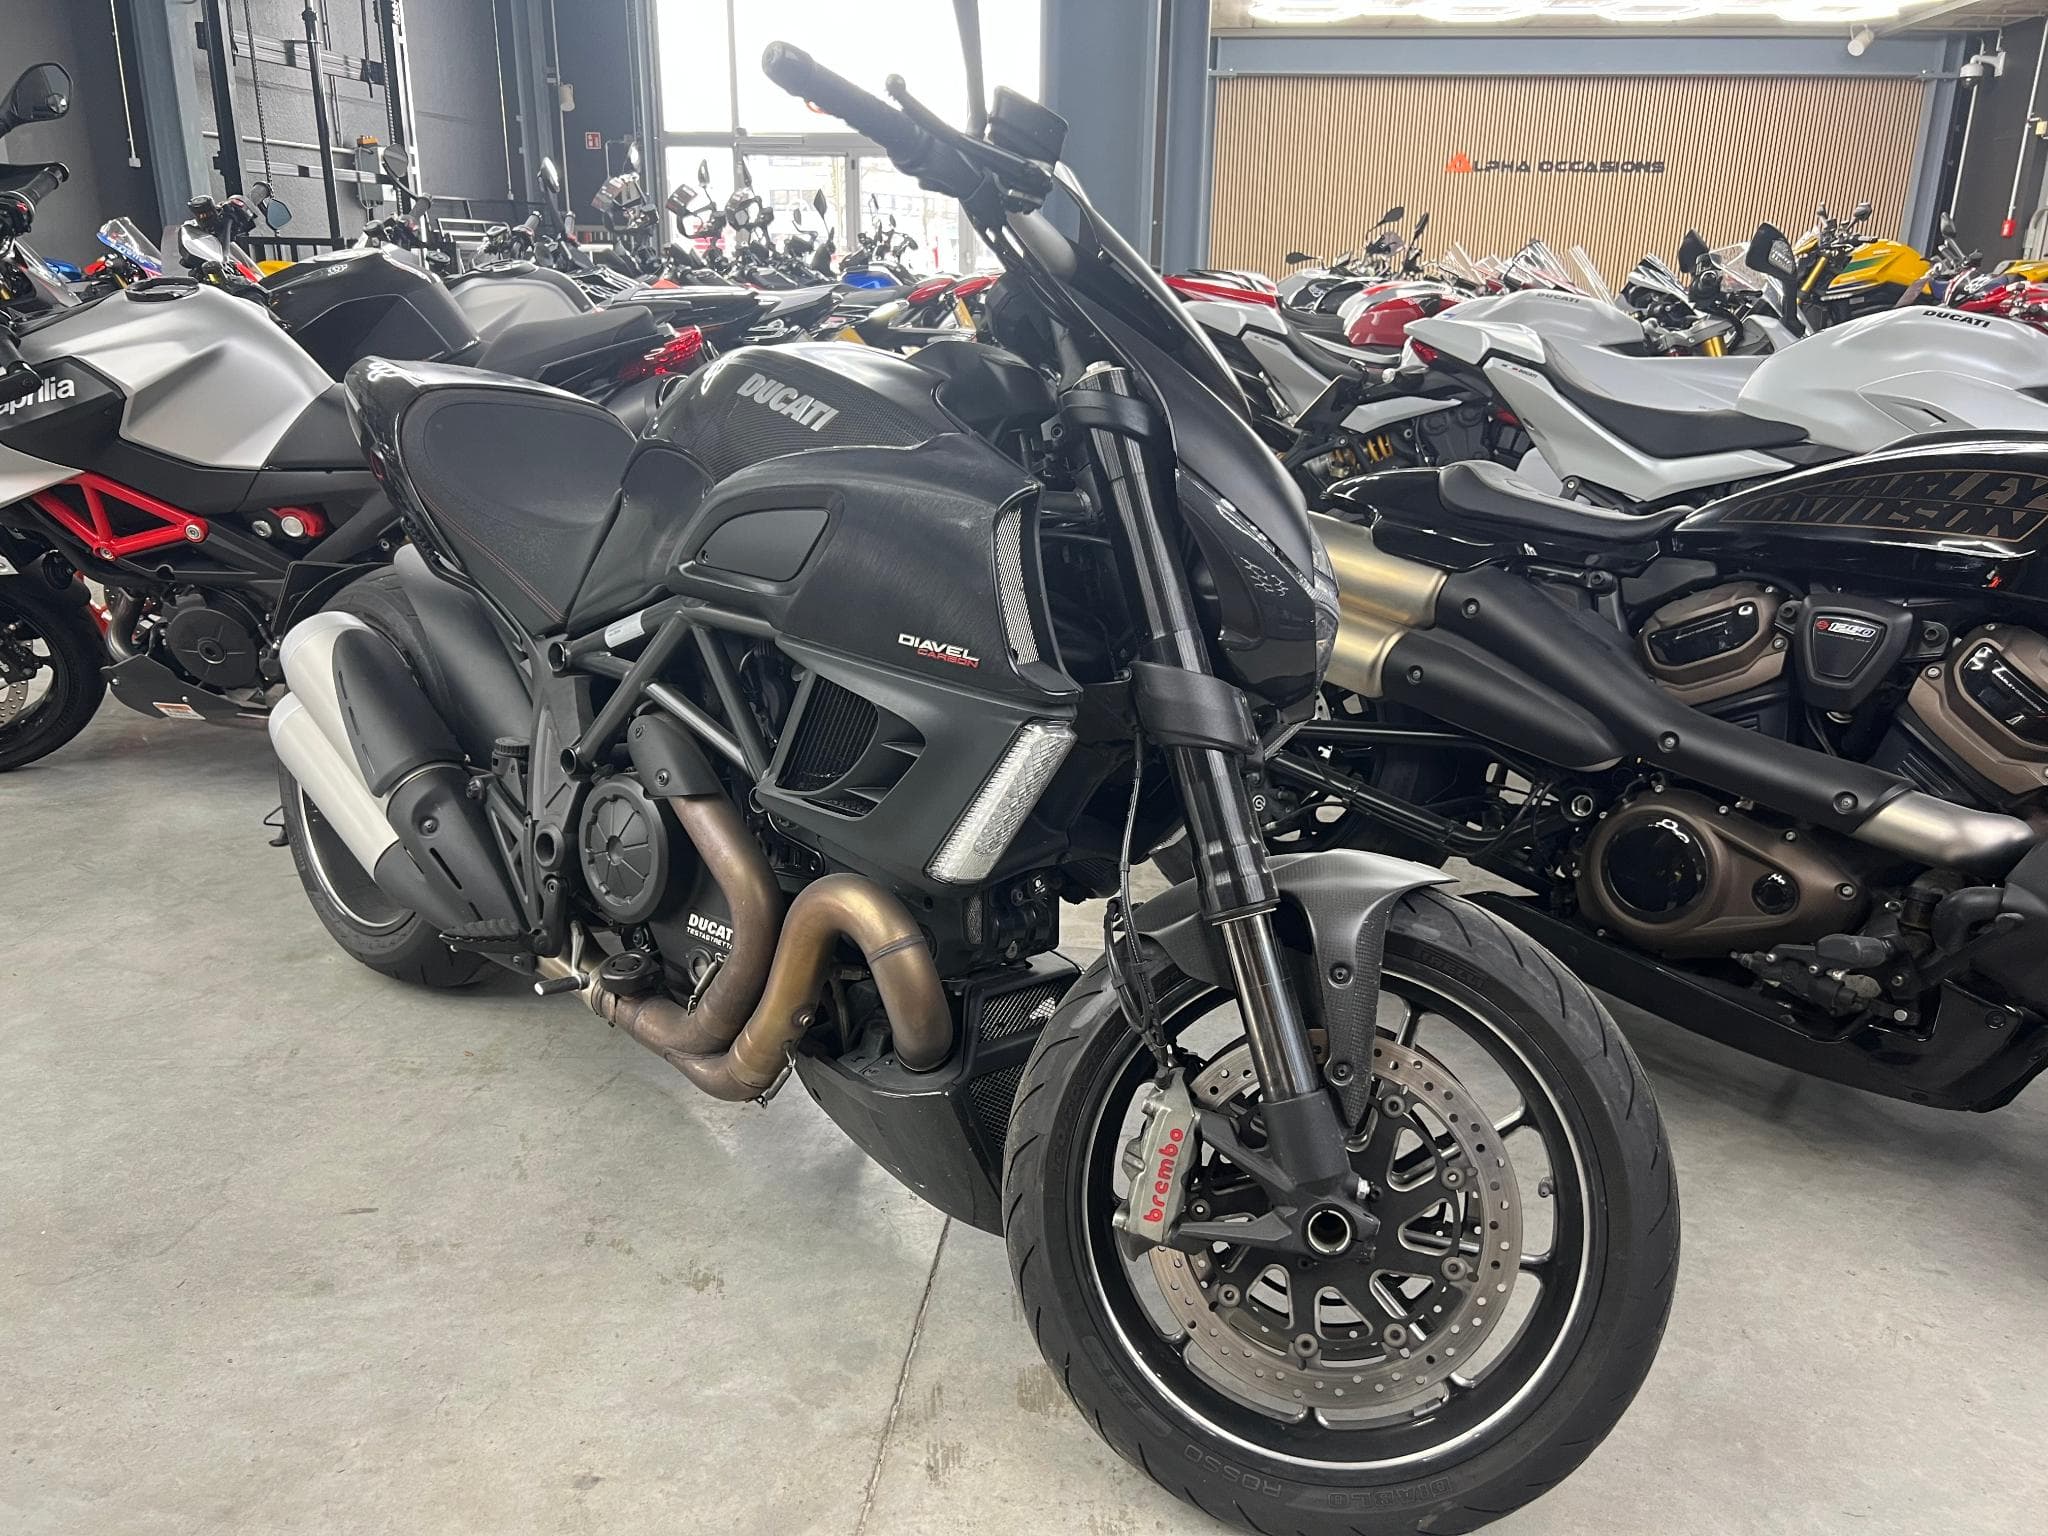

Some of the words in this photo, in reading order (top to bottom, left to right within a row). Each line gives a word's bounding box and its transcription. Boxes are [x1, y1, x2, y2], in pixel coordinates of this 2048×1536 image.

[1538, 160, 1665, 173] OCCASIONS
[1536, 292, 1580, 303] DUCATI
[1922, 310, 1991, 328] DUCATI
[0, 376, 76, 415] prilia
[736, 372, 840, 432] DUCATI
[898, 633, 980, 662] DIAVEL
[917, 648, 980, 669] CARBON
[688, 913, 734, 941] DUCAT
[1143, 1128, 1184, 1222] brembo
[1184, 1444, 1282, 1497] ROSSO
[1328, 1476, 1450, 1507] DIABLO
